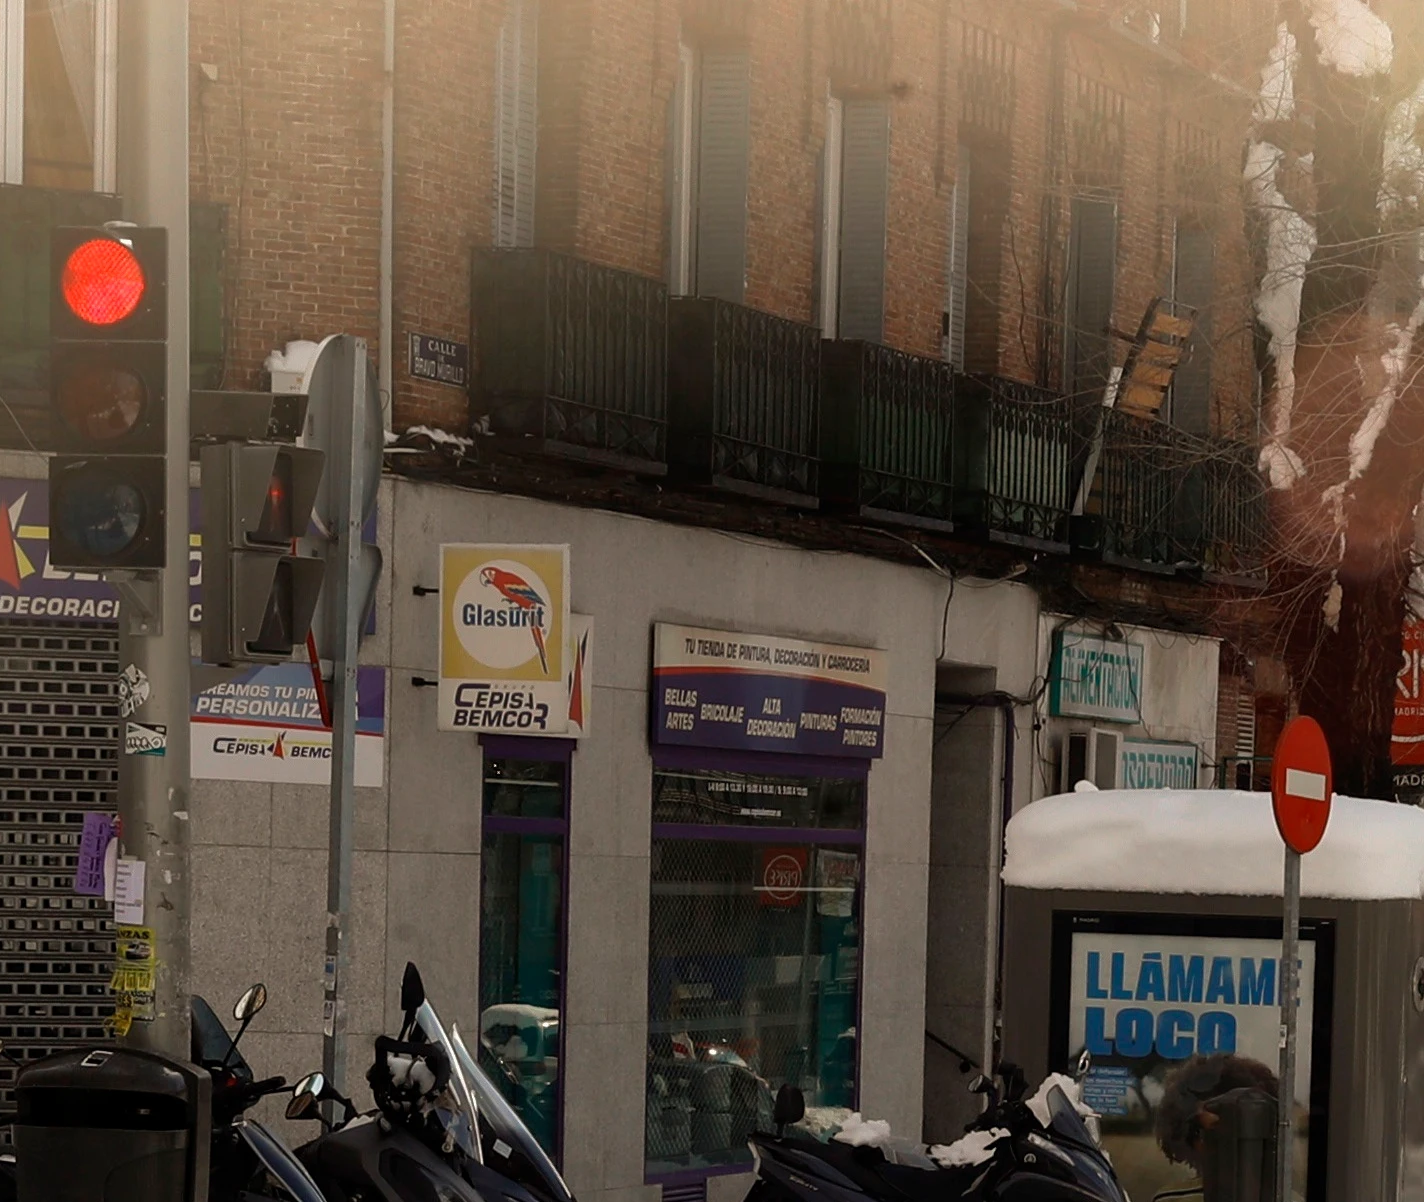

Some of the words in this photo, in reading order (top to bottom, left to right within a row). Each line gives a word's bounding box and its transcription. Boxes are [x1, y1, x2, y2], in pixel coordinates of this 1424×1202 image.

[428, 340, 456, 356] CALLE
[462, 603, 544, 628] Glasurit
[685, 637, 697, 654] TU
[697, 639, 726, 658] TIENDA
[726, 644, 738, 660] DE
[739, 645, 772, 665] PINTURA,
[774, 648, 820, 669] DECORACIÓN
[820, 653, 827, 669] Y
[274, 686, 292, 699] TU
[454, 683, 534, 710] CEPISA
[665, 688, 698, 708] BELLAS
[453, 703, 549, 730] BEMCOR
[700, 703, 745, 724] BRICOLAJE
[762, 698, 781, 715] ALTA
[840, 706, 882, 726] FORMACIÓN
[666, 712, 695, 731] ARTES
[746, 719, 797, 740] DECORACIÓN
[799, 712, 838, 732] PINTURAS
[213, 737, 266, 756] CEPISA
[290, 745, 332, 759] BEMC
[841, 729, 878, 747] PINTORES
[1085, 1006, 1237, 1060] LOCO
